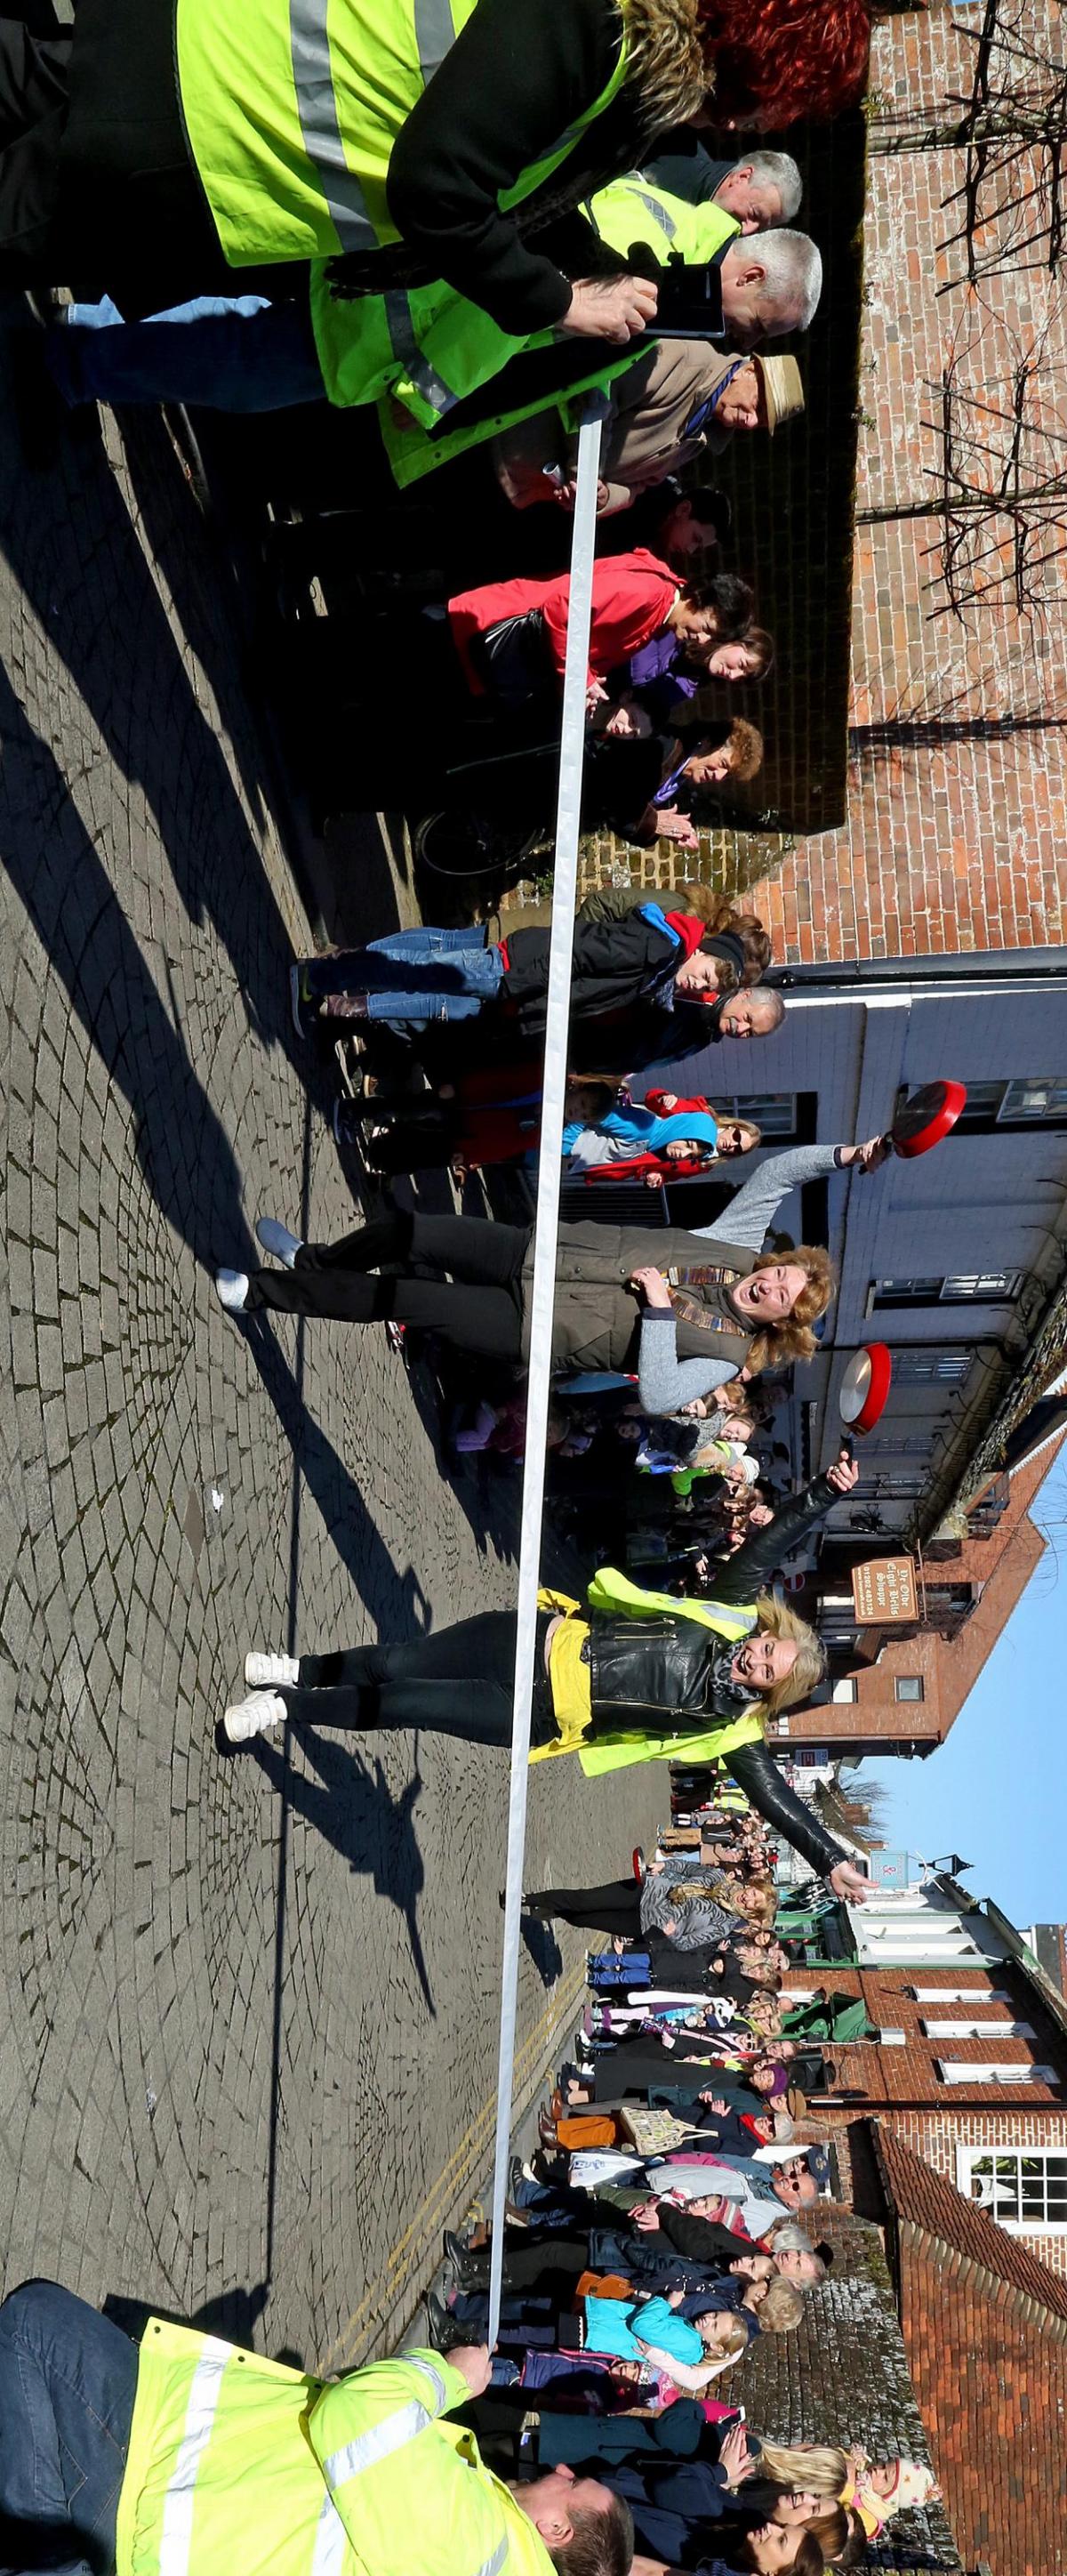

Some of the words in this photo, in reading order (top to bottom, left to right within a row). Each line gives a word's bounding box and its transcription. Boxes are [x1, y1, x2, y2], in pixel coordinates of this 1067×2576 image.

[863, 1566, 871, 1589] 01202
[886, 1563, 896, 1587] Eight
[897, 1569, 909, 1582] Ye
[876, 1573, 886, 1607] Shoppe
[900, 1584, 910, 1607] Olde
[889, 1590, 899, 1615] Bells
